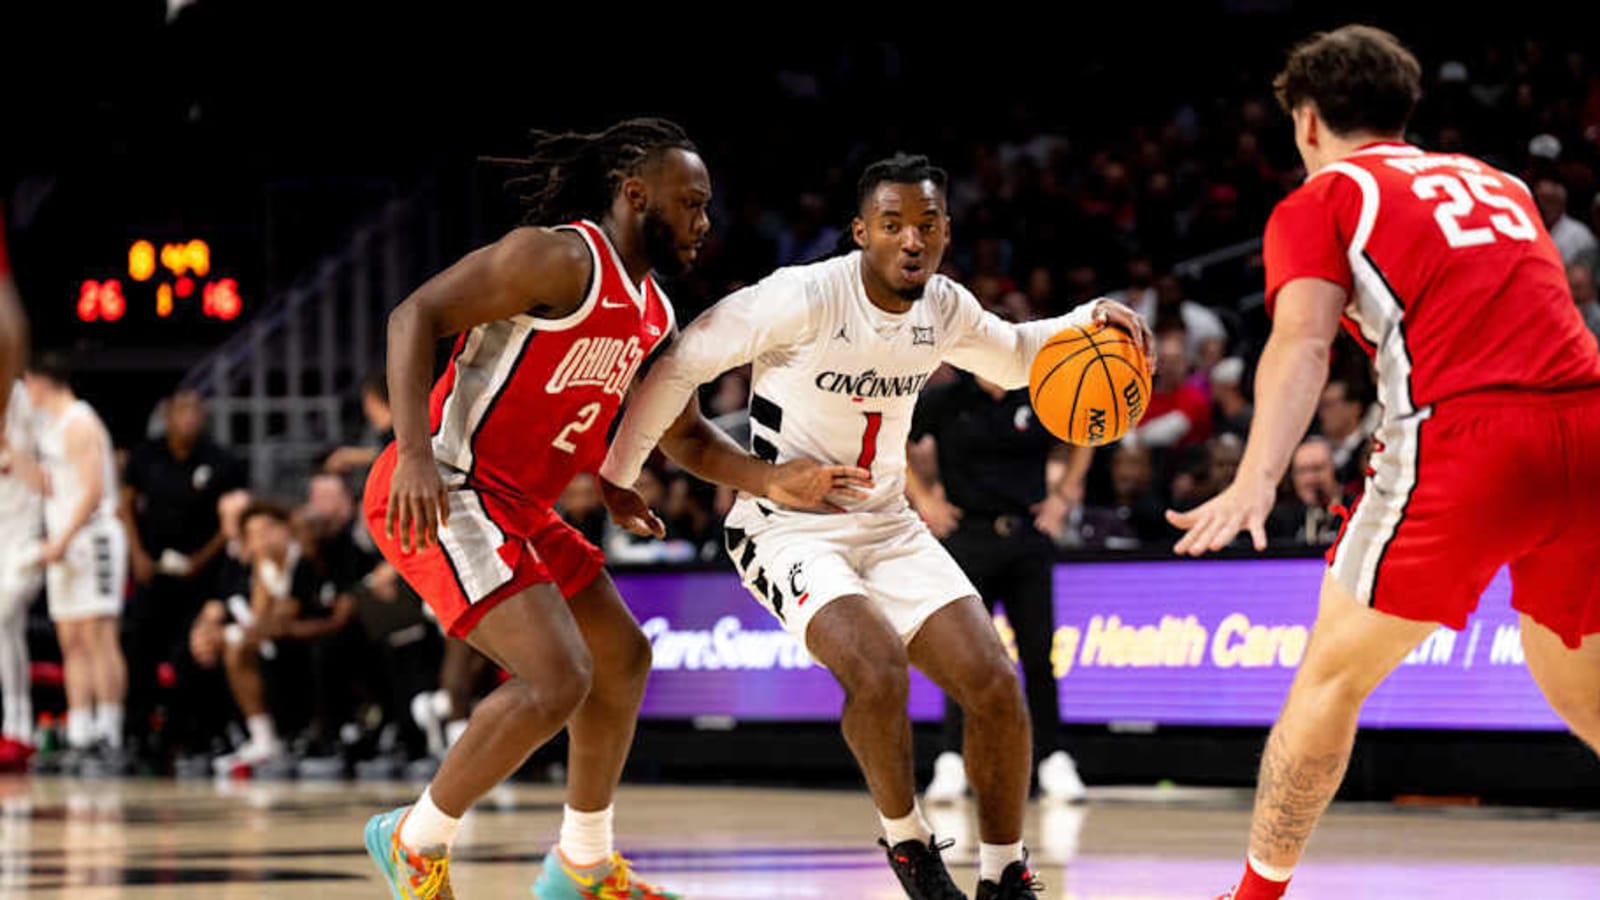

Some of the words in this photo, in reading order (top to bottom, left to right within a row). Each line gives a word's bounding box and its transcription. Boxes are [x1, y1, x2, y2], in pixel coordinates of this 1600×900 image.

[1412, 170, 1537, 249] 25
[552, 402, 600, 453] 2
[857, 411, 882, 479] 1
[1088, 408, 1105, 442] NCA
[1079, 614, 1207, 669] Health
